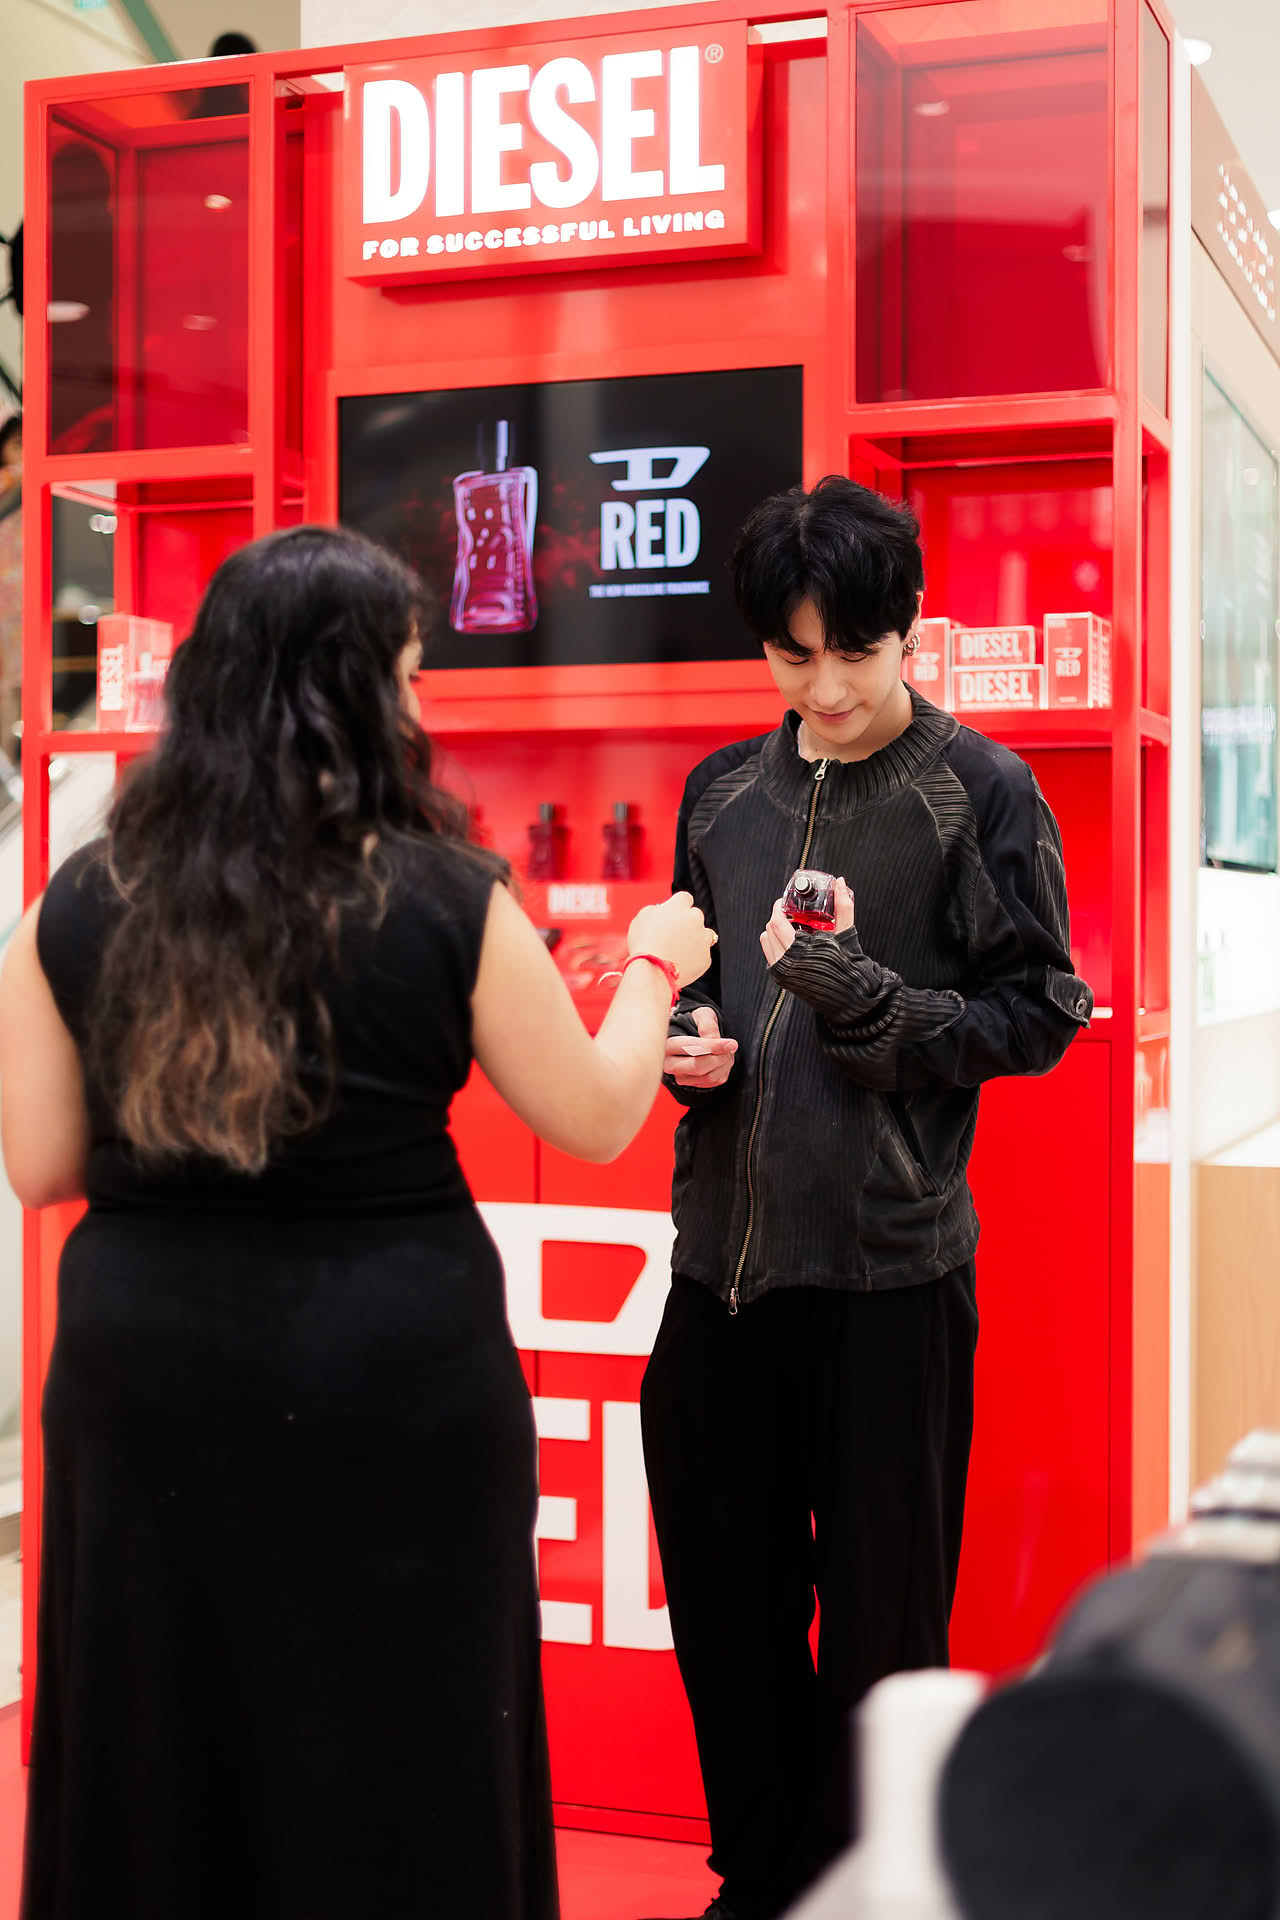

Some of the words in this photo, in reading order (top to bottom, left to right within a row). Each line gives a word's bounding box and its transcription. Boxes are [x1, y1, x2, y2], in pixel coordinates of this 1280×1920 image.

[363, 45, 725, 224] DIESEL
[363, 239, 419, 260] FOR
[426, 219, 615, 254] SUCCESSFUL
[624, 209, 726, 238] LIVING
[600, 498, 700, 570] RED
[960, 632, 1023, 659] DIESEL
[959, 671, 1034, 701] DIESEL
